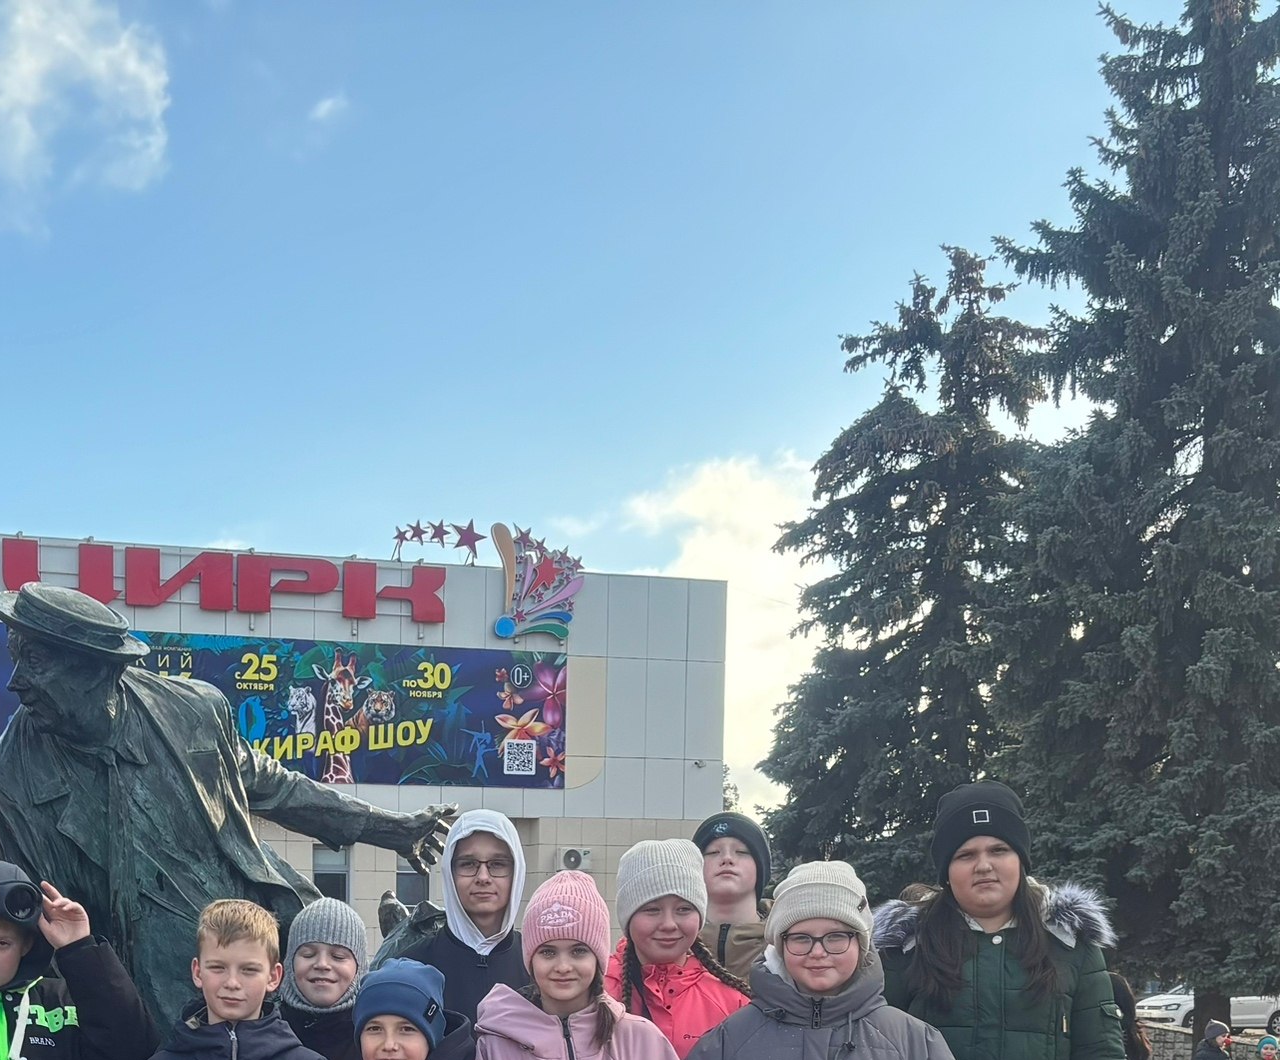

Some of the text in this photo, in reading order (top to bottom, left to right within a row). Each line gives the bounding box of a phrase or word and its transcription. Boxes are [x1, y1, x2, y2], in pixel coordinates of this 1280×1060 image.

[2, 538, 447, 623] ЦИРК
[241, 653, 278, 681] 25
[403, 662, 451, 688] по 30
[514, 667, 529, 682] 0+
[236, 682, 274, 691] ОКТЯБРЯ
[410, 690, 442, 699] НОЯБРЯ
[368, 718, 433, 750] ШОУ
